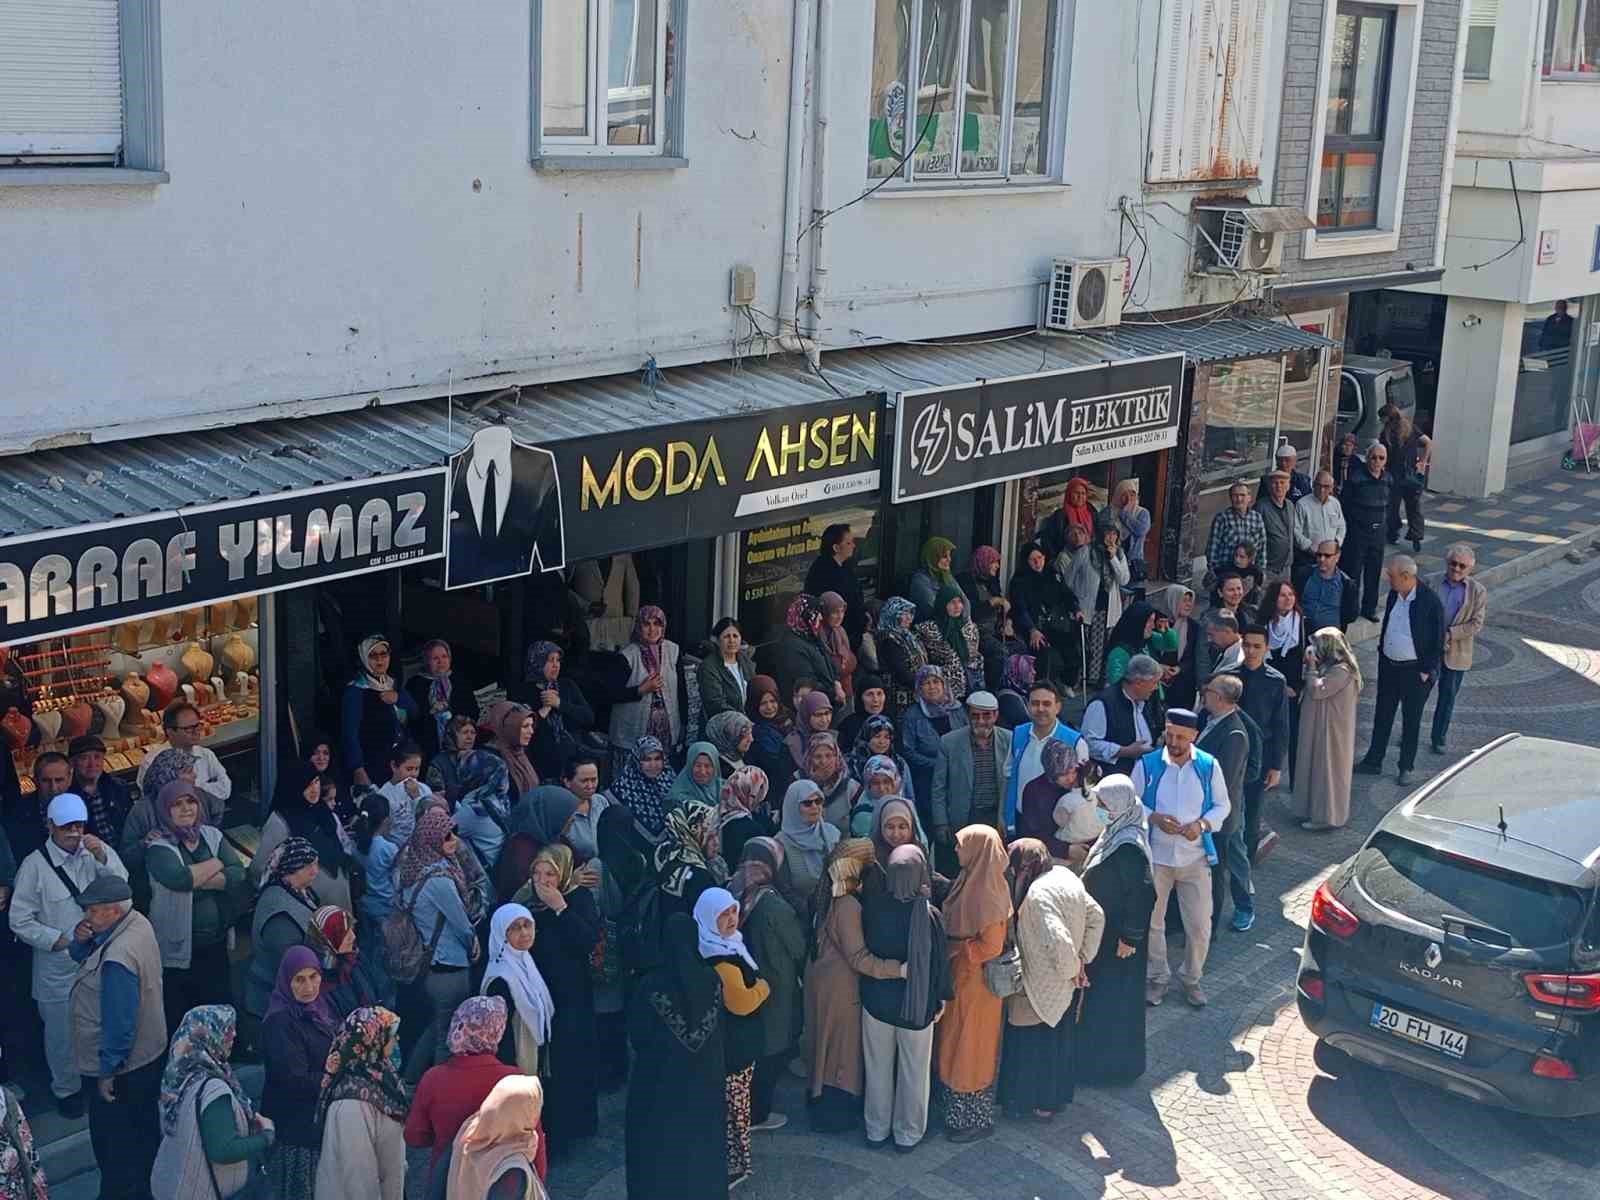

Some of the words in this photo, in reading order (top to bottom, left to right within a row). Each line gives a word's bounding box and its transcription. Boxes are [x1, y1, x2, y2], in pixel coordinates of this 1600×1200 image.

[580, 435, 728, 511] MODA
[745, 411, 877, 482] AHSEN
[218, 491, 426, 581] YILMAZ
[1399, 961, 1463, 989] KADJAR
[1380, 1008, 1399, 1028] 20
[1406, 1018, 1431, 1040] FH
[1440, 1030, 1465, 1053] 144
